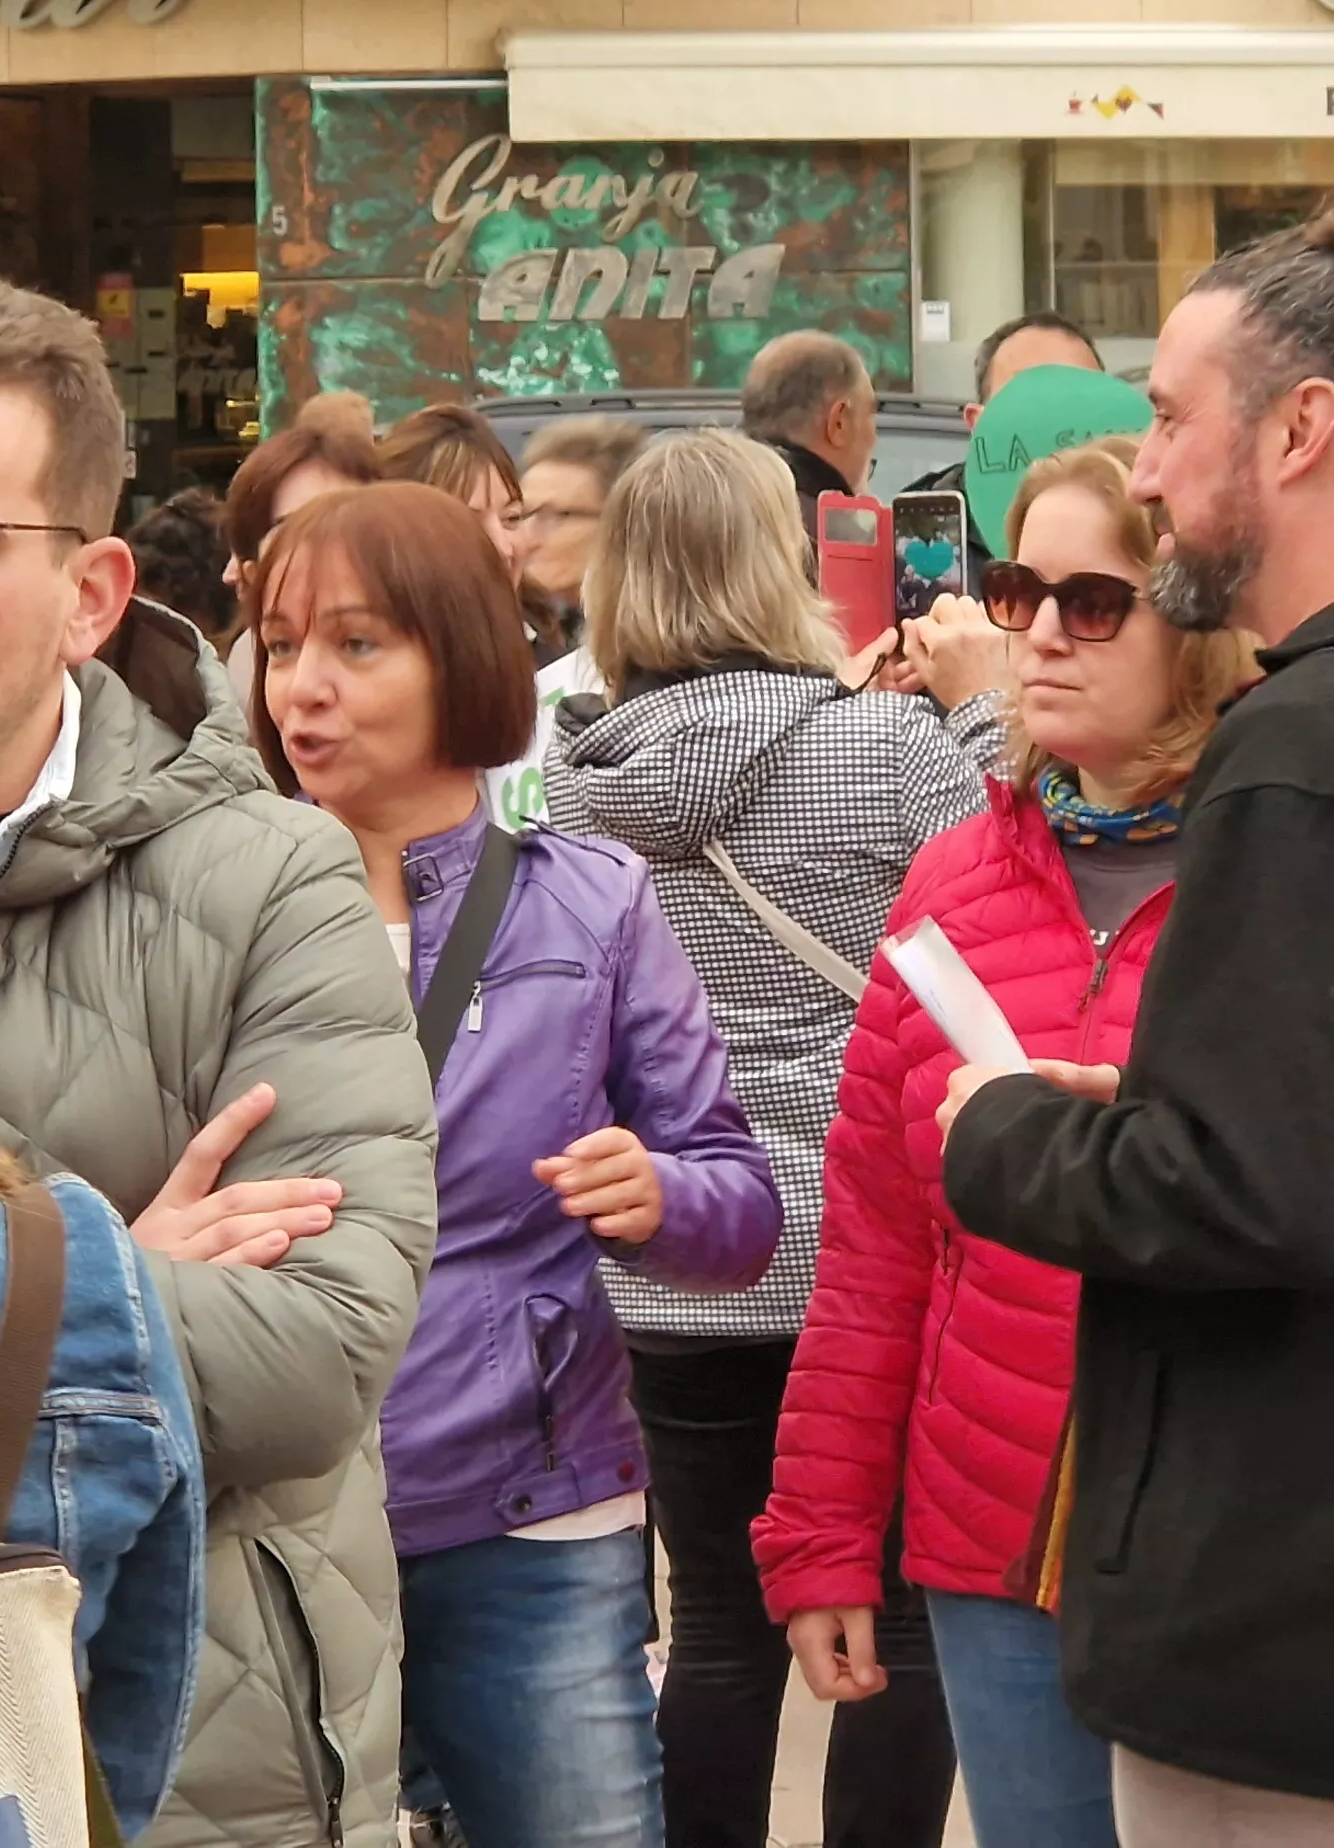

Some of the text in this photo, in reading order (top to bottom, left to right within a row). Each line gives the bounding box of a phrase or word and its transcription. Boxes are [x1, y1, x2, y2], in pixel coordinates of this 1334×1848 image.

[271, 204, 288, 236] 5
[424, 134, 705, 289] Granja
[478, 243, 787, 321] ANITA
[975, 433, 1031, 475] LA
